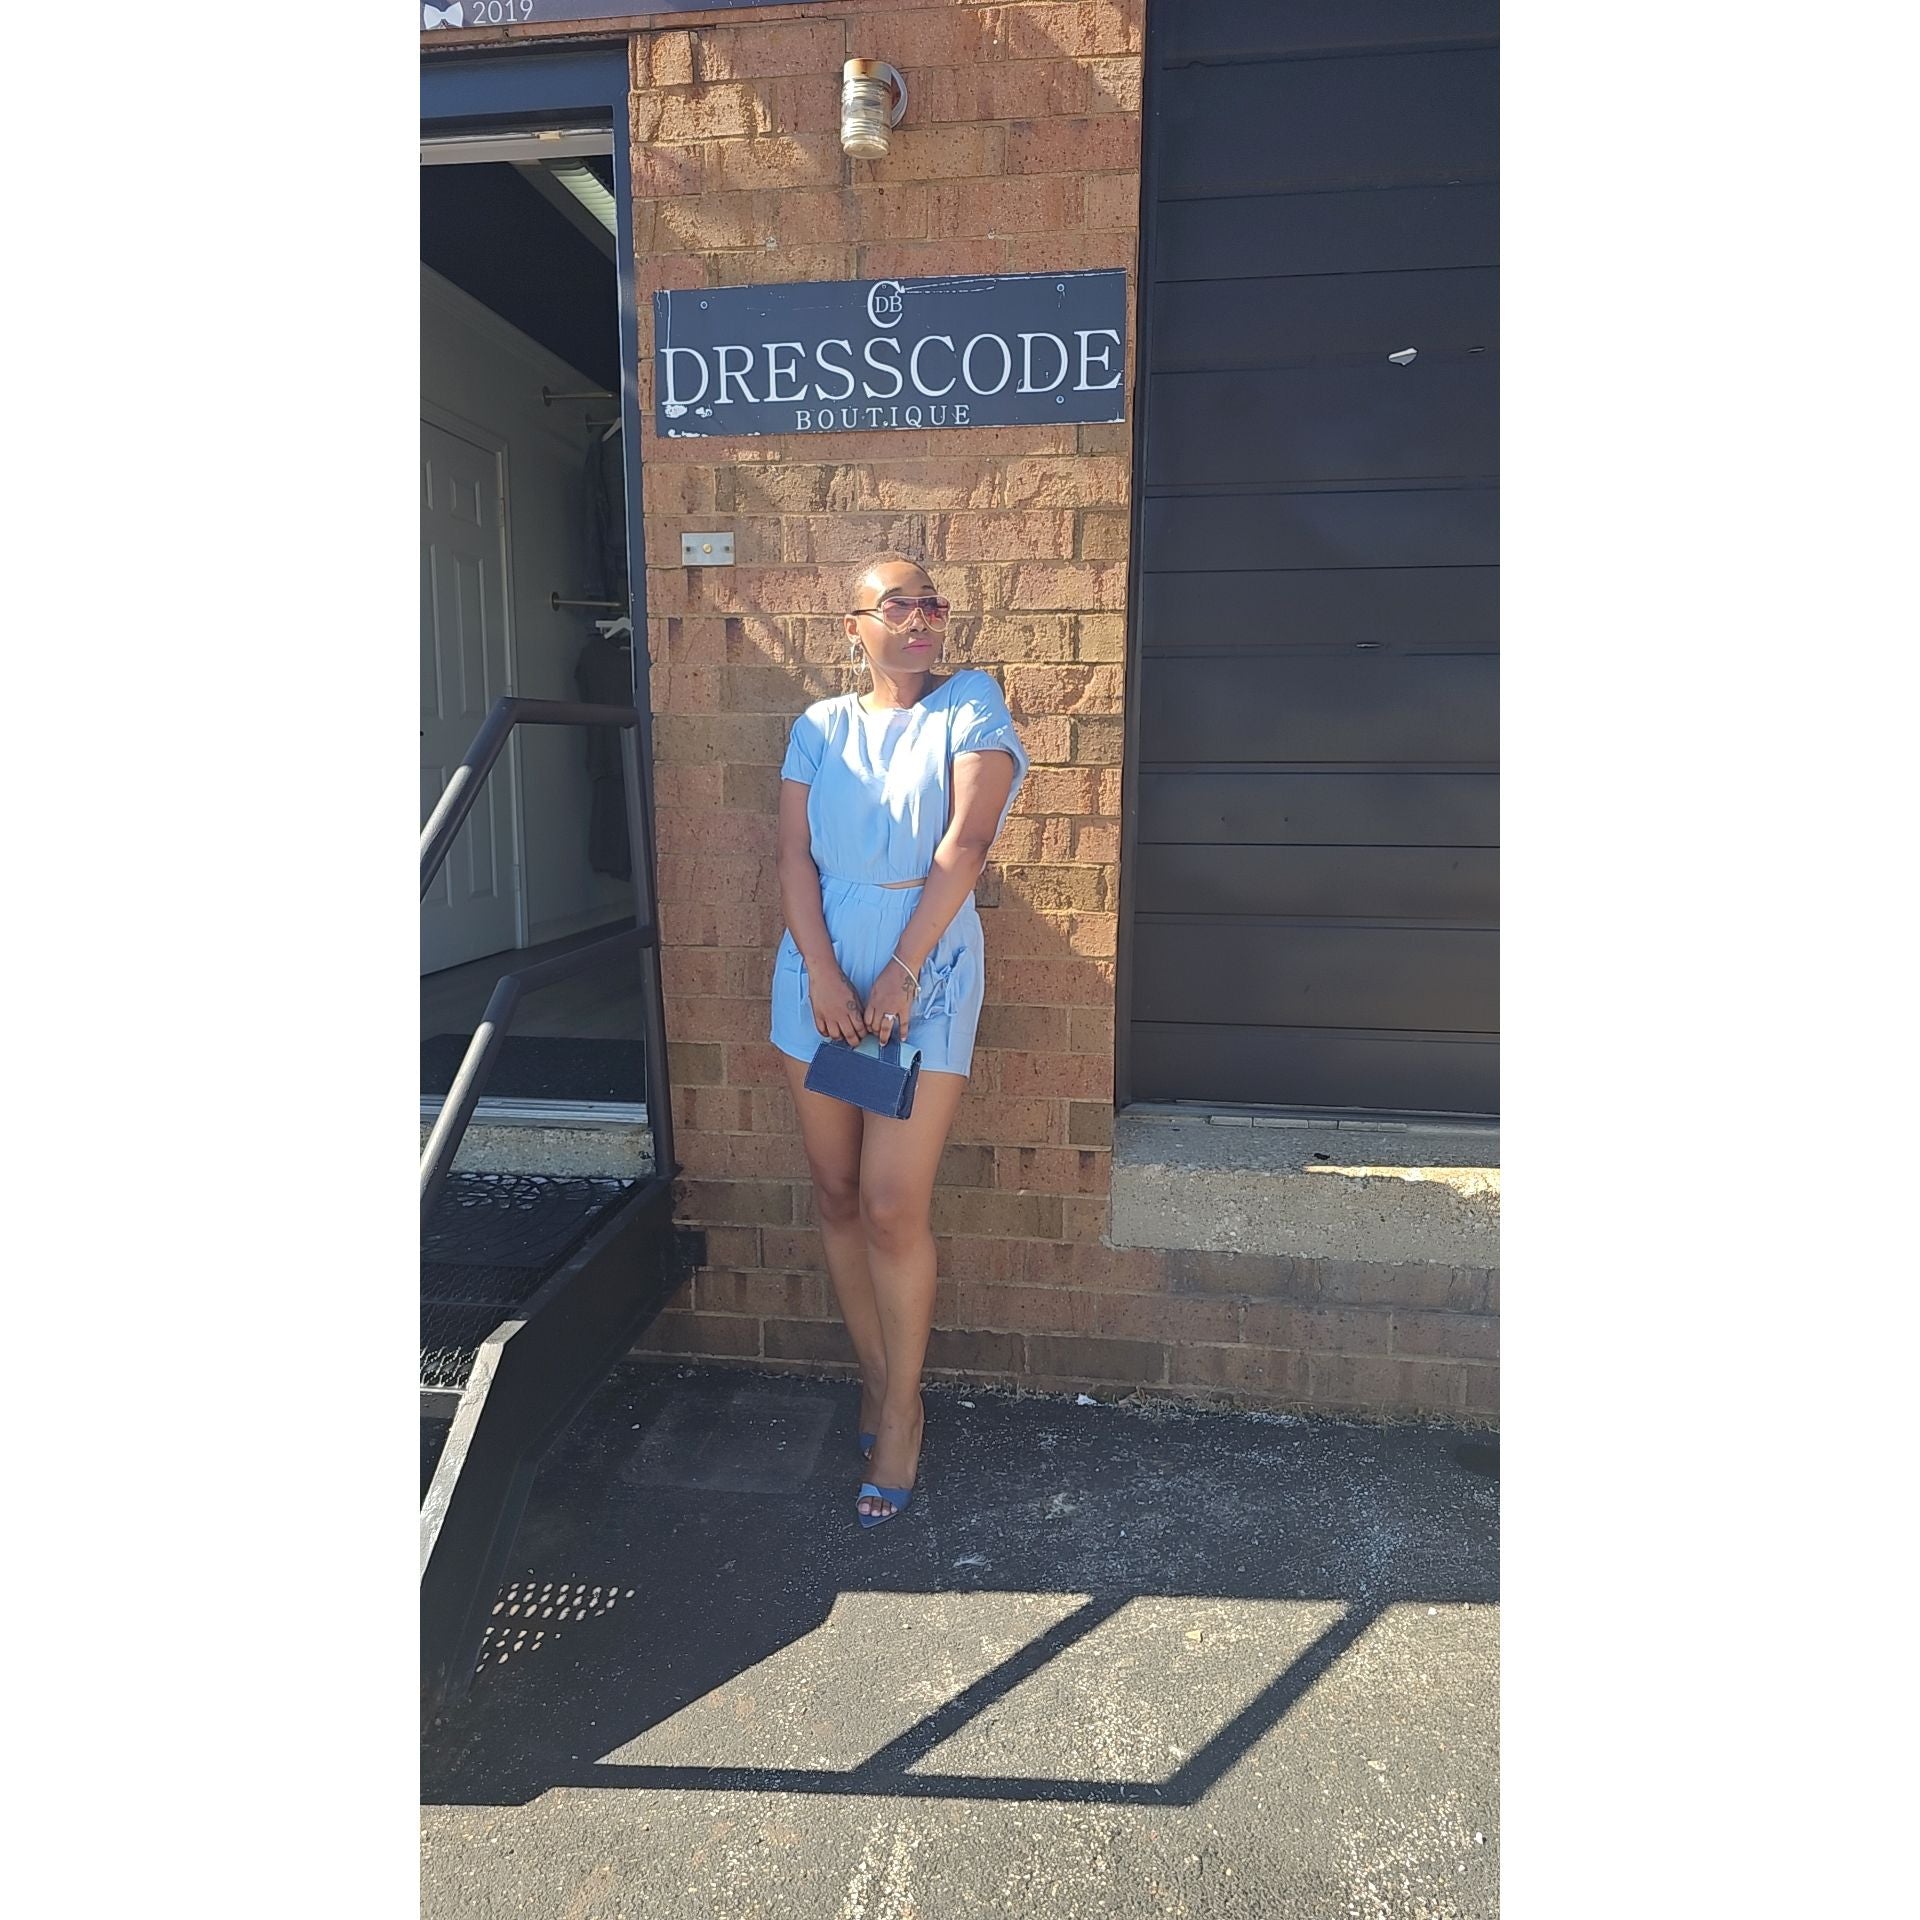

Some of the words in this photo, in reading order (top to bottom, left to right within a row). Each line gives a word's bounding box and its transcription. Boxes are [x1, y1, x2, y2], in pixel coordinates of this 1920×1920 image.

[472, 0, 534, 24] 2019
[660, 329, 1122, 405] DRESSCODE
[795, 404, 971, 430] BOUTIQUE
